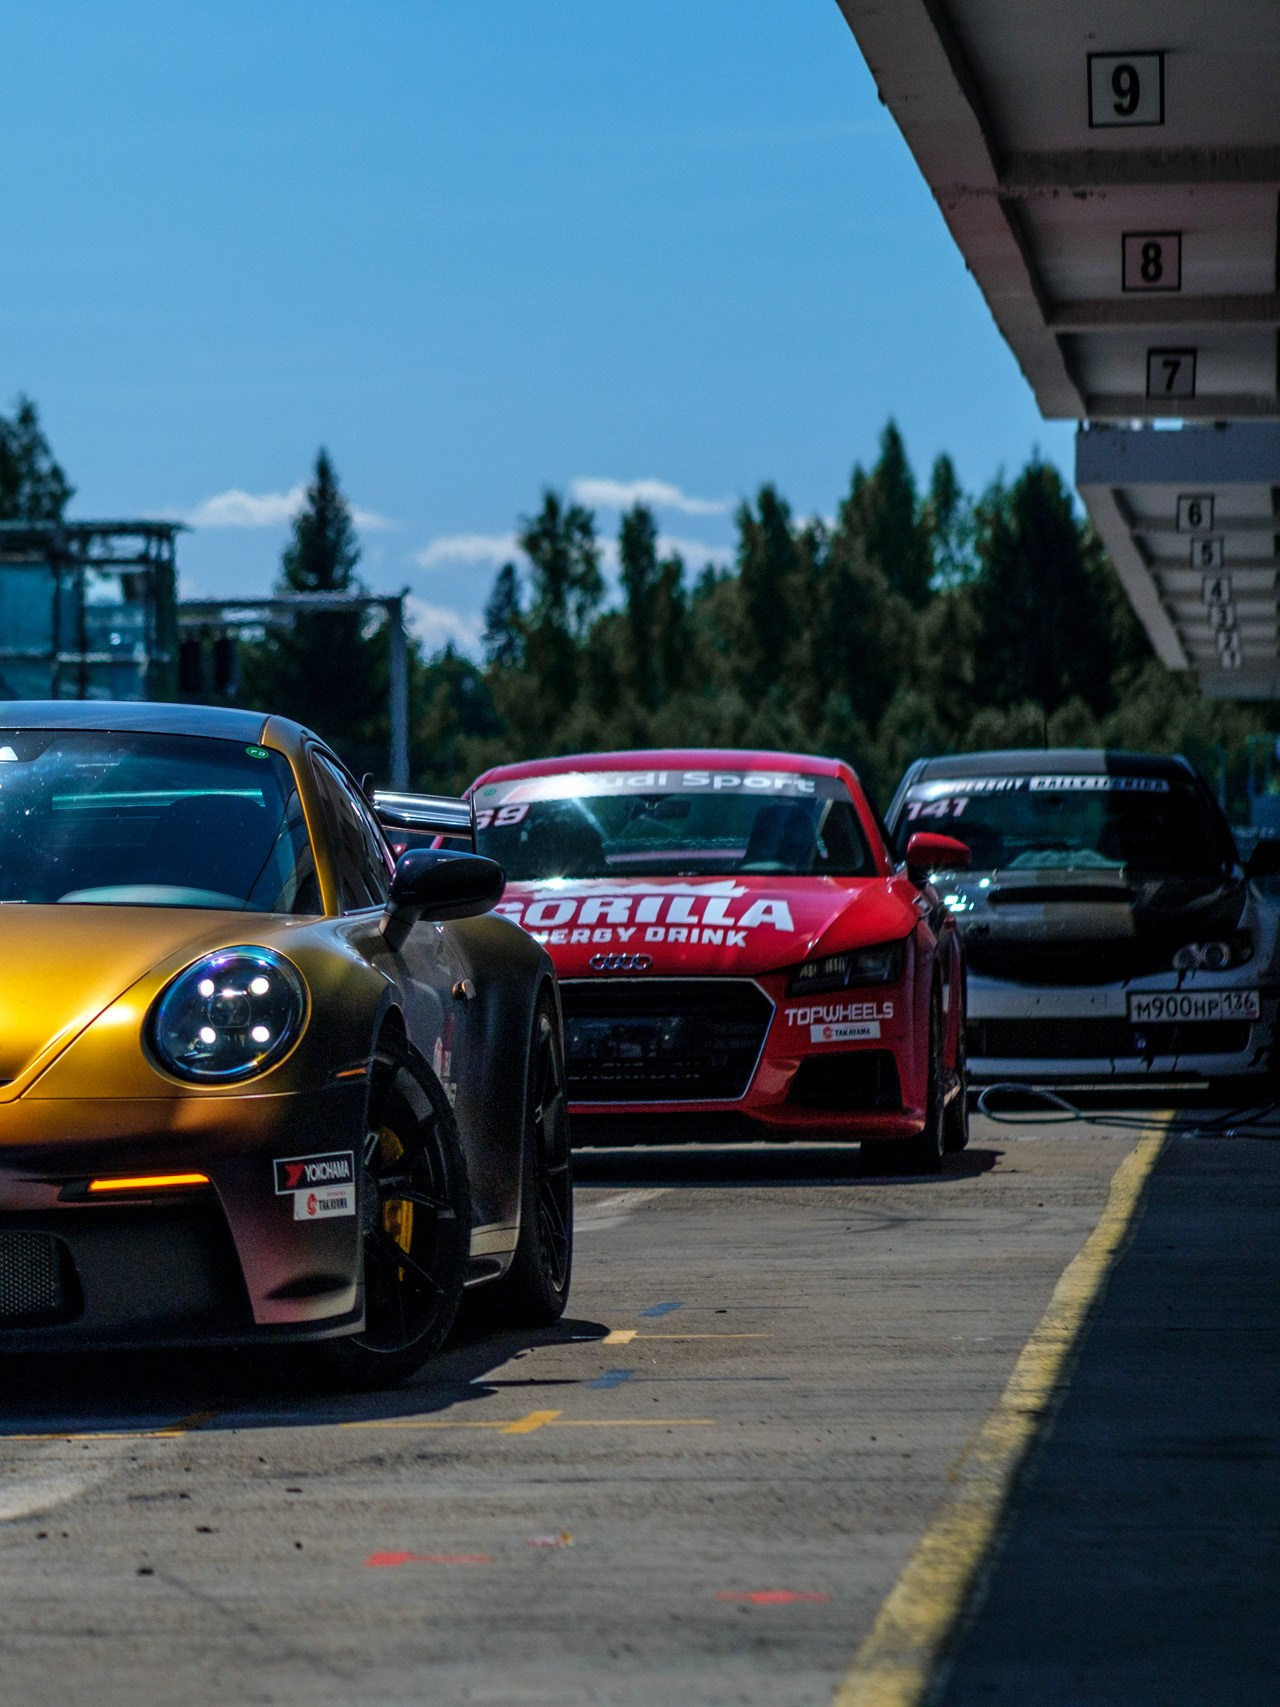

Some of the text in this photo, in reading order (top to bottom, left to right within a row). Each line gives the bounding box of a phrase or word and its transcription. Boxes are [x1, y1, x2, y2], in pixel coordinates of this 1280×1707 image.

[1111, 64, 1140, 117] 9
[1141, 241, 1163, 282] 8
[1162, 360, 1181, 392] 7
[1188, 501, 1202, 527] 6
[682, 772, 816, 794] Sport
[906, 797, 970, 821] 141
[528, 927, 749, 947] NERGY DRINK
[784, 1001, 894, 1027] TOPWHEELS
[304, 1160, 350, 1182] YOKOHAMA
